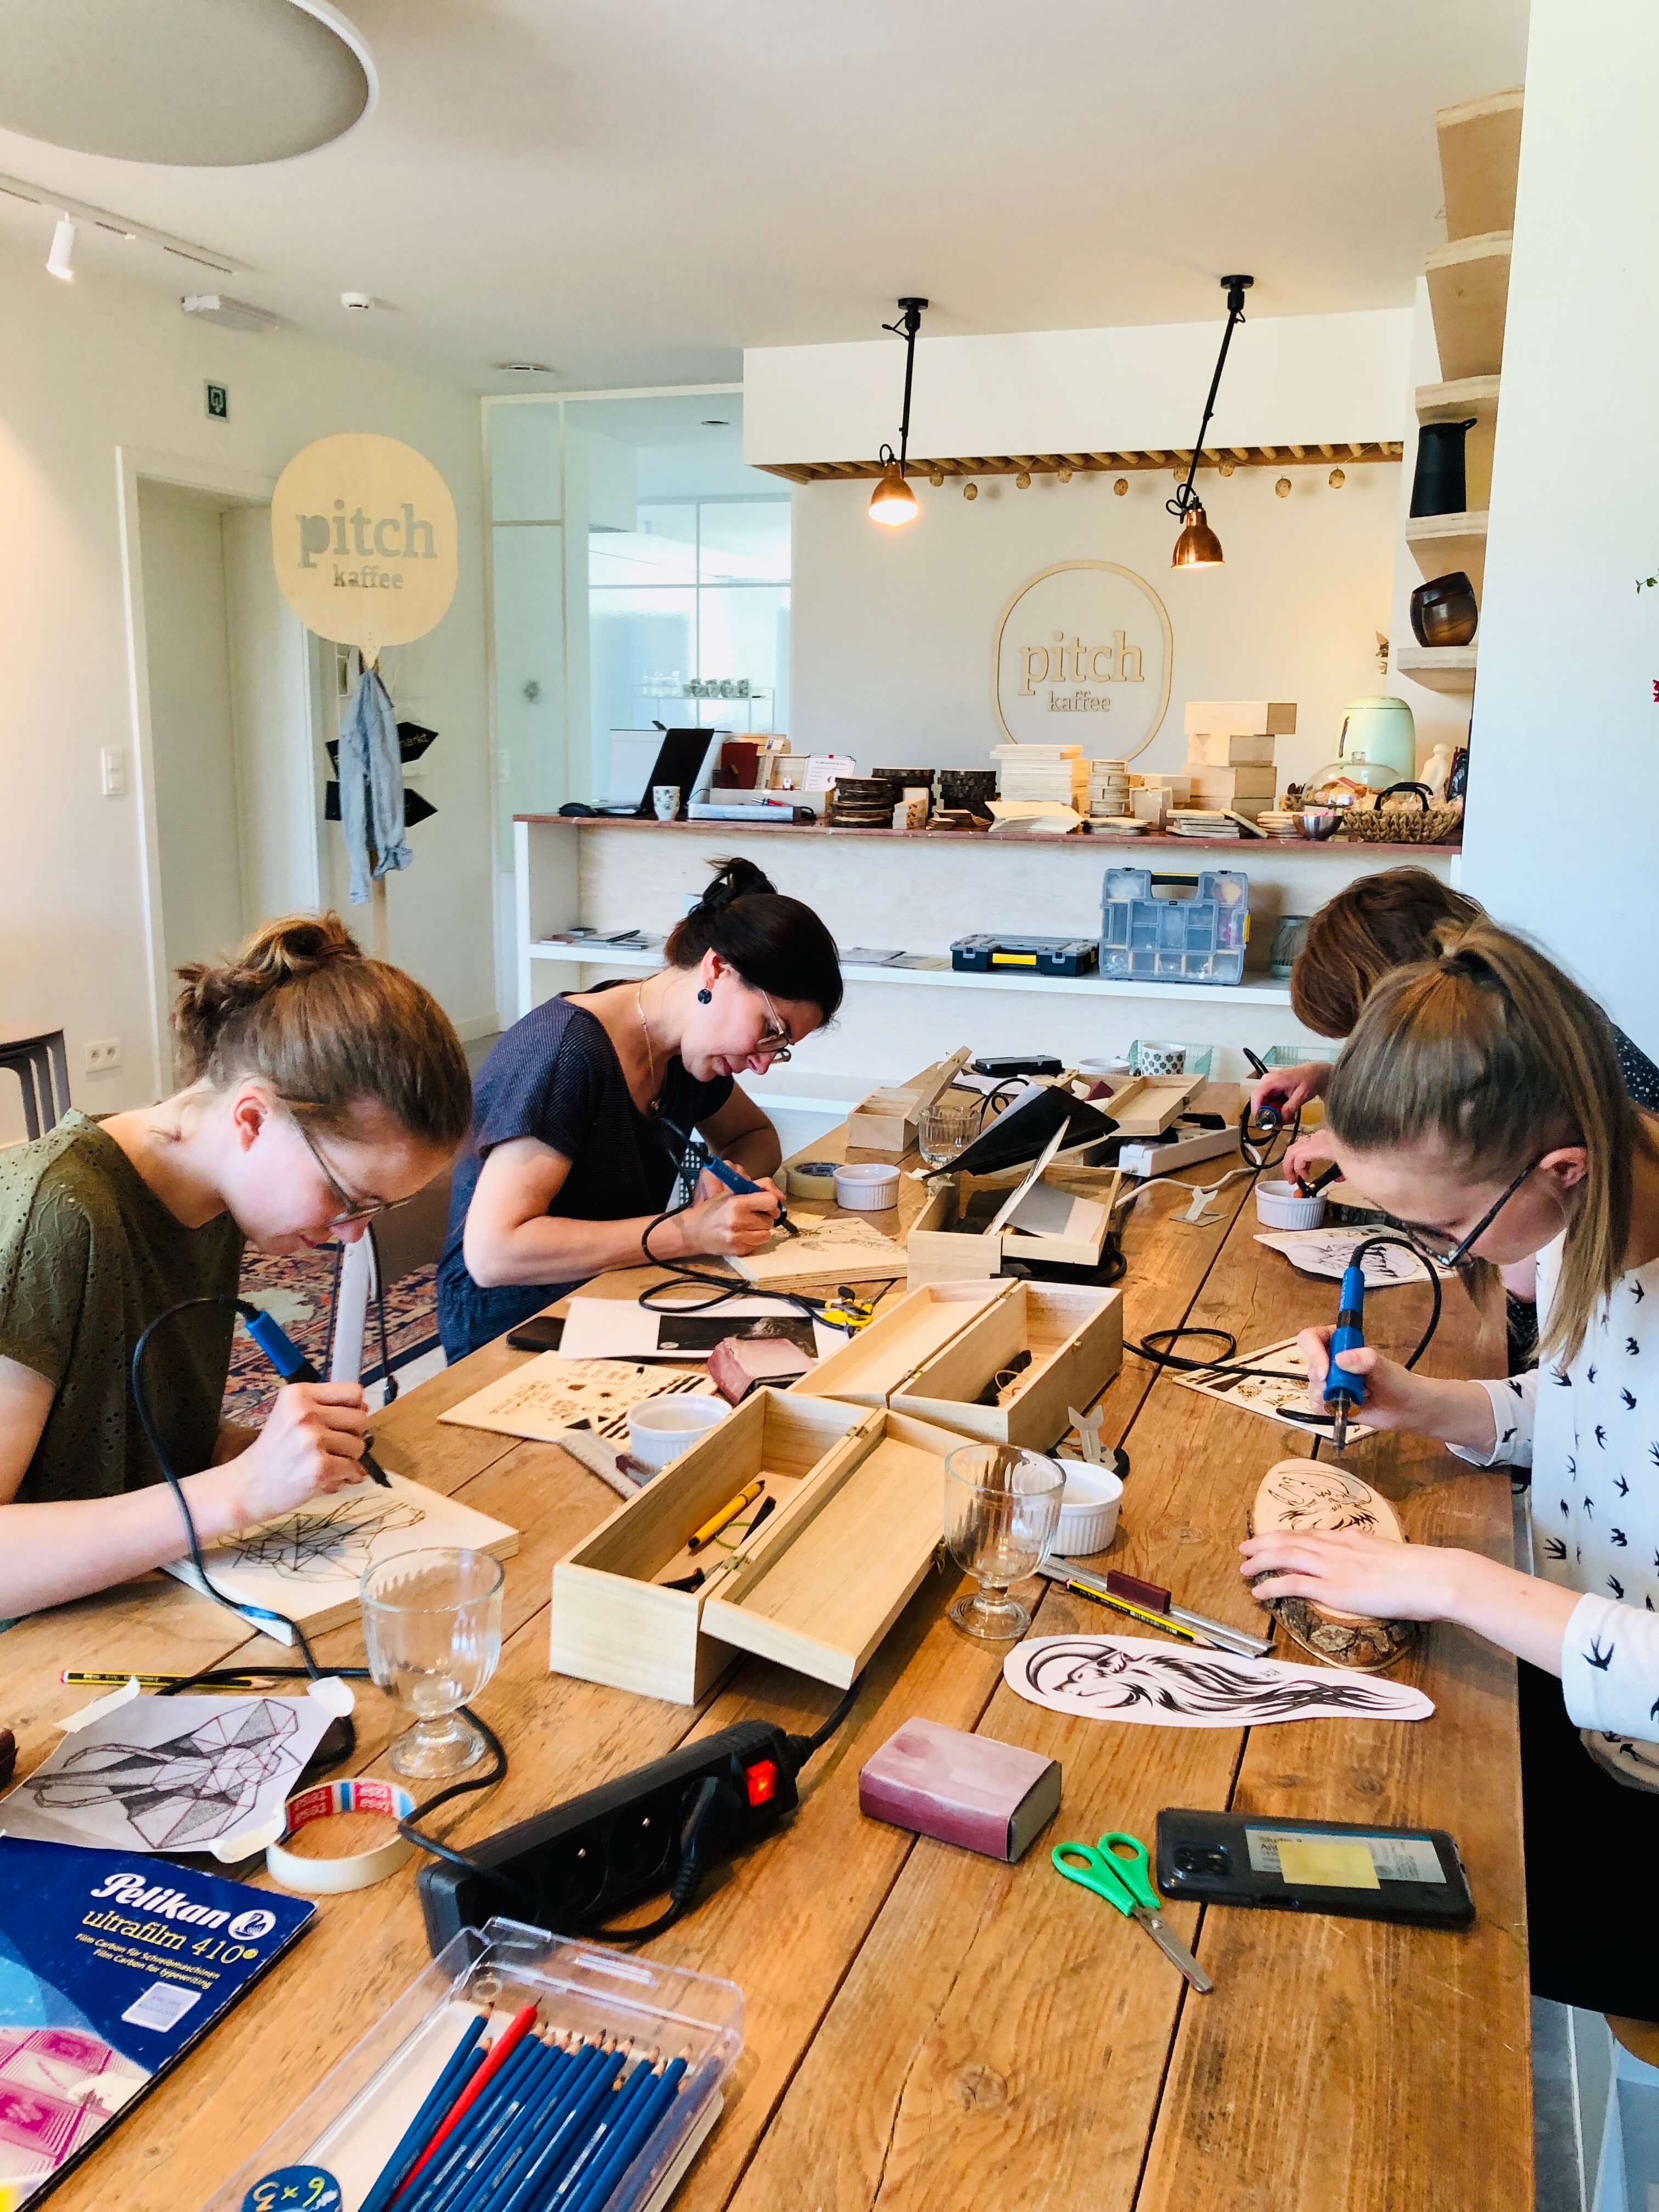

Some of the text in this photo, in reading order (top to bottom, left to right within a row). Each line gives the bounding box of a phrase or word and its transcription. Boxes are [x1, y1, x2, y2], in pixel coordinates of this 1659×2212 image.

[296, 499, 438, 568] pitch
[333, 564, 404, 589] kaffee
[1018, 630, 1144, 696] pitch
[1048, 690, 1111, 712] kaffee
[90, 1873, 232, 1929] Pelikan
[82, 1910, 187, 1950] ultrafilm
[75, 1933, 94, 1944] Film
[94, 1938, 126, 1954] Carbon
[143, 1951, 221, 1979] Schreibmaschinen
[93, 1948, 112, 1960] Film
[113, 1953, 145, 1970] Carbon
[160, 1966, 213, 1990] typewriting
